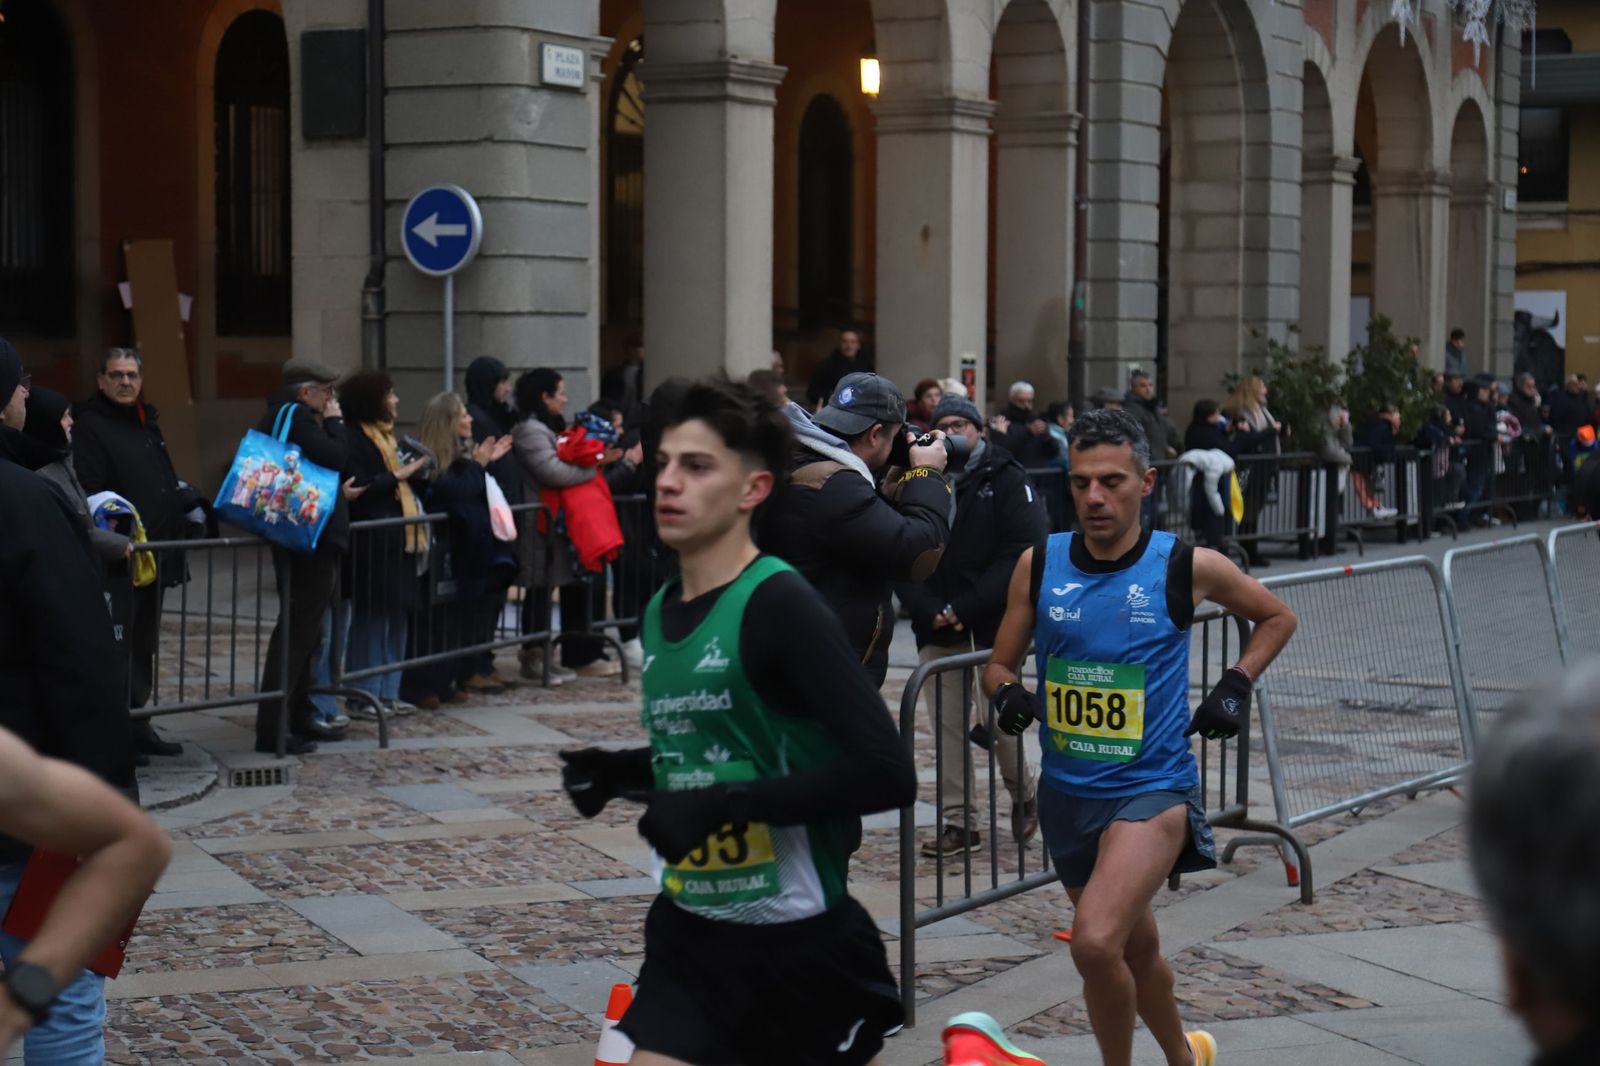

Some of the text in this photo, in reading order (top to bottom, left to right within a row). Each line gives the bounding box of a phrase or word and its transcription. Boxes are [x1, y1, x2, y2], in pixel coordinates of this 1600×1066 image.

[1067, 672, 1115, 683] CAJA RURAL
[650, 688, 733, 715] universidad
[1051, 687, 1126, 731] 1058
[1069, 740, 1136, 757] CAJA RURAL
[684, 874, 770, 894] CAJA RURAL
